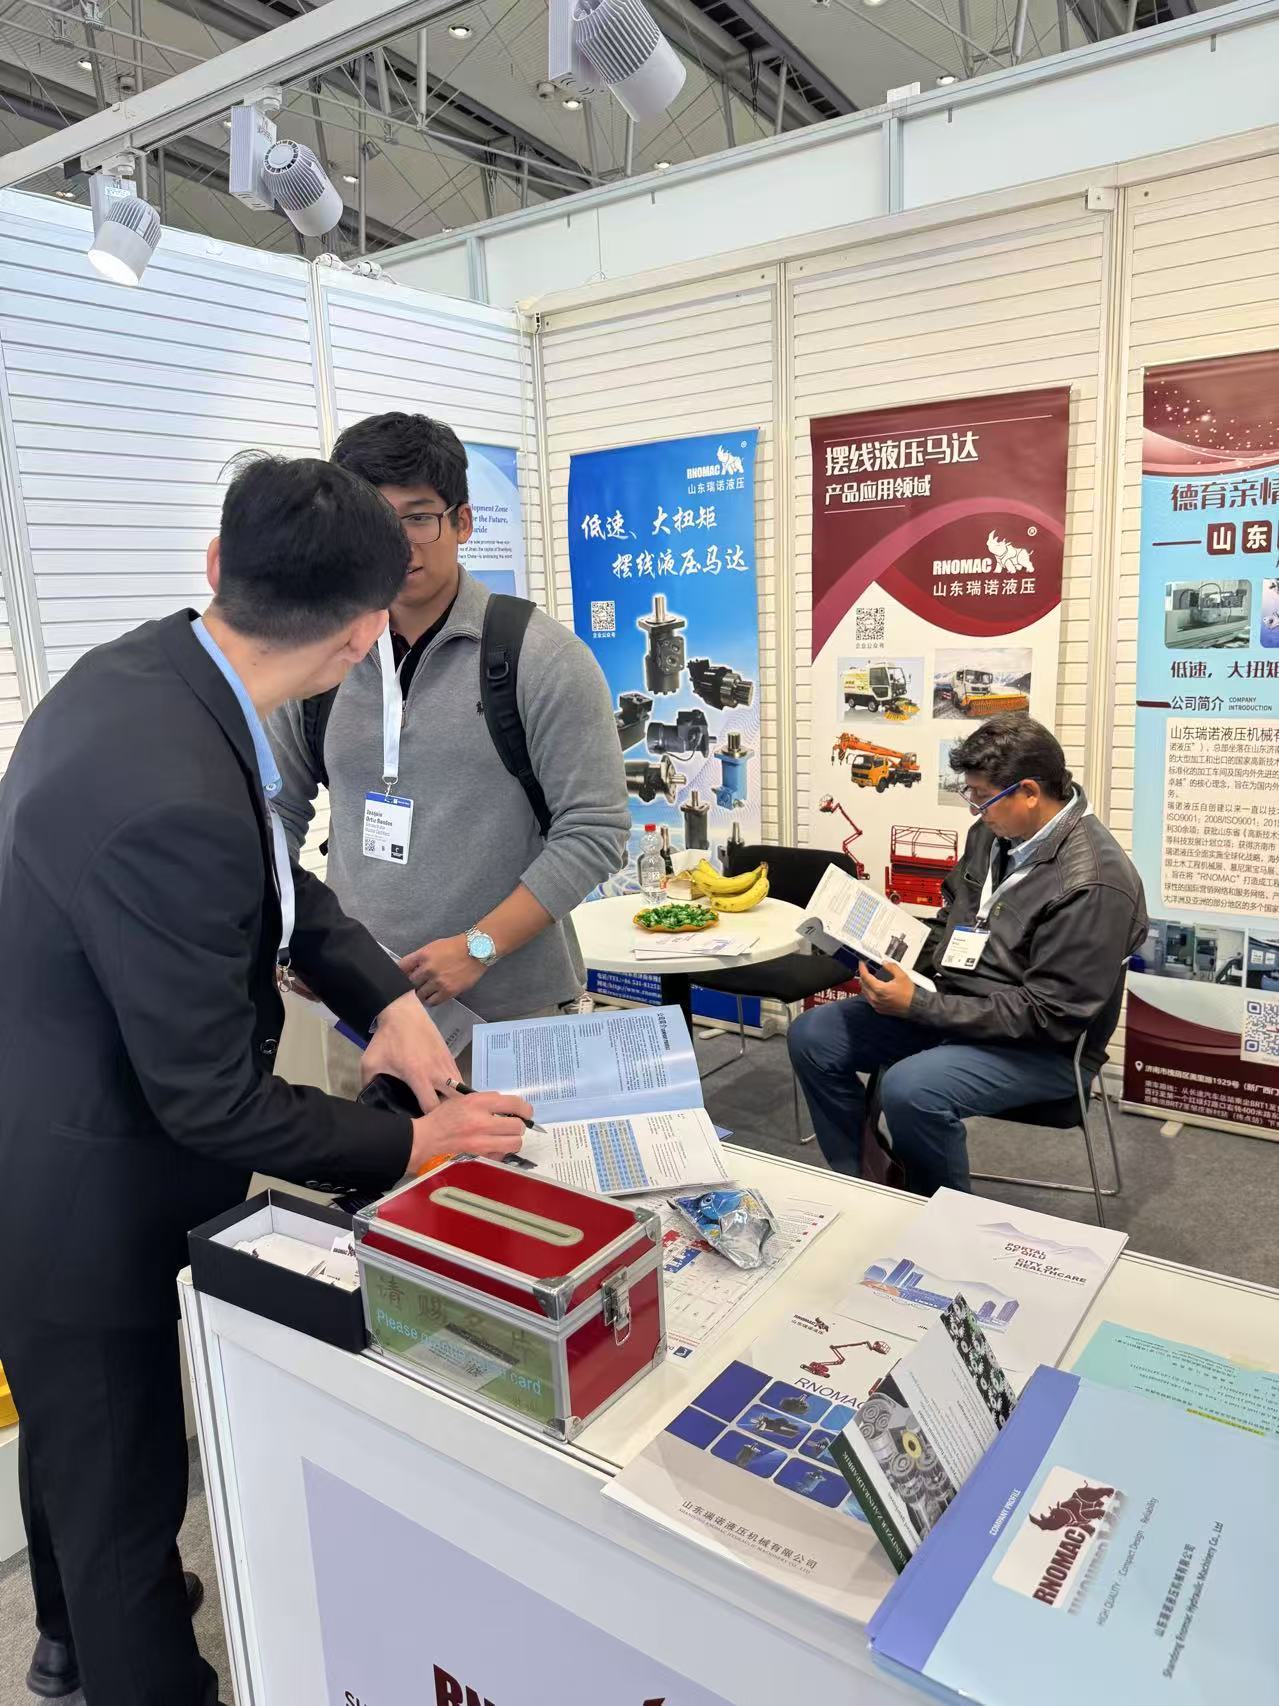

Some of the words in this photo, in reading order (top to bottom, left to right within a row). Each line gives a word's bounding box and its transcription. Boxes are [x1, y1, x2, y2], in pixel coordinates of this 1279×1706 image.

[824, 431, 980, 476] 摆线液压马达
[686, 464, 720, 479] RNOMAC
[687, 477, 745, 495] 山东瑞诺液压
[825, 475, 931, 505] 产品应用领域
[612, 545, 749, 579] 摆线液压马达
[933, 558, 993, 575] RNOMAC
[933, 578, 1036, 596] 山东瑞诺液压
[1171, 696, 1224, 711] 公司简介
[1007, 1242, 1046, 1256] PORTAL
[1017, 1258, 1043, 1268] CITY
[1015, 1262, 1087, 1283] HEALTHCARE
[376, 1308, 418, 1341] Please
[510, 1372, 542, 1395] card
[989, 1509, 1009, 1536] COMPANY
[1004, 1488, 1021, 1511] PROFILE
[682, 1500, 818, 1570] 山东瑞诺液压机械有限公司
[1032, 1527, 1086, 1606] RNOMAC
[1104, 1581, 1120, 1609] QUALITY
[1119, 1549, 1137, 1577] Compact
[1130, 1529, 1145, 1550] Design
[1162, 1641, 1185, 1680] Shandong
[1176, 1614, 1194, 1642] Rnomac
[1187, 1582, 1204, 1615] Hydraulic
[1197, 1546, 1218, 1583] Machinery
